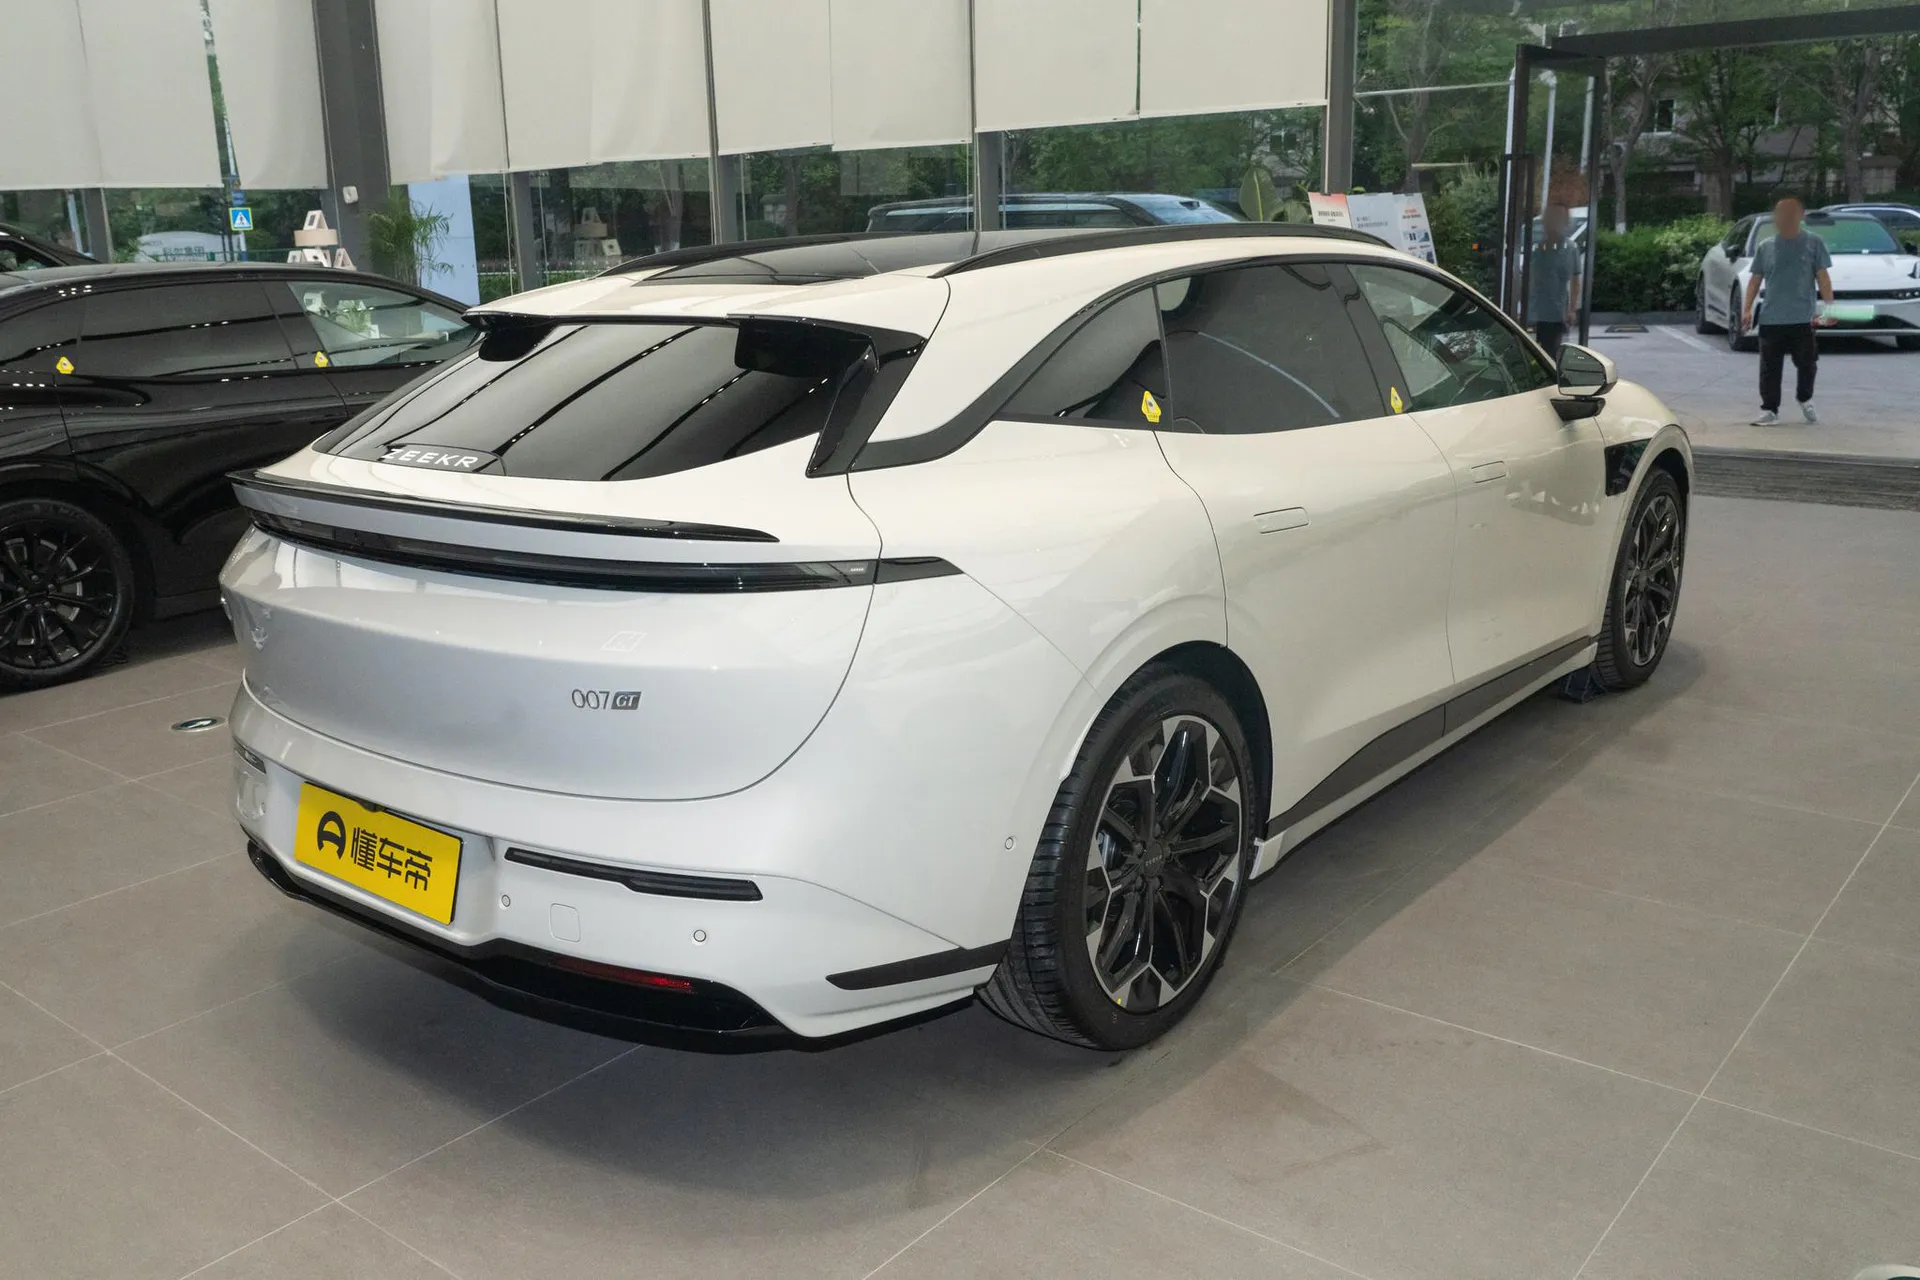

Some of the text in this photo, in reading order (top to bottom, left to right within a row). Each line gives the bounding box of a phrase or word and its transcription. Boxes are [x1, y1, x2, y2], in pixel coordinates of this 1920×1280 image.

[381, 448, 479, 468] ZEEKR
[571, 689, 639, 710] 007 GT
[350, 827, 433, 891] 懂车帝
